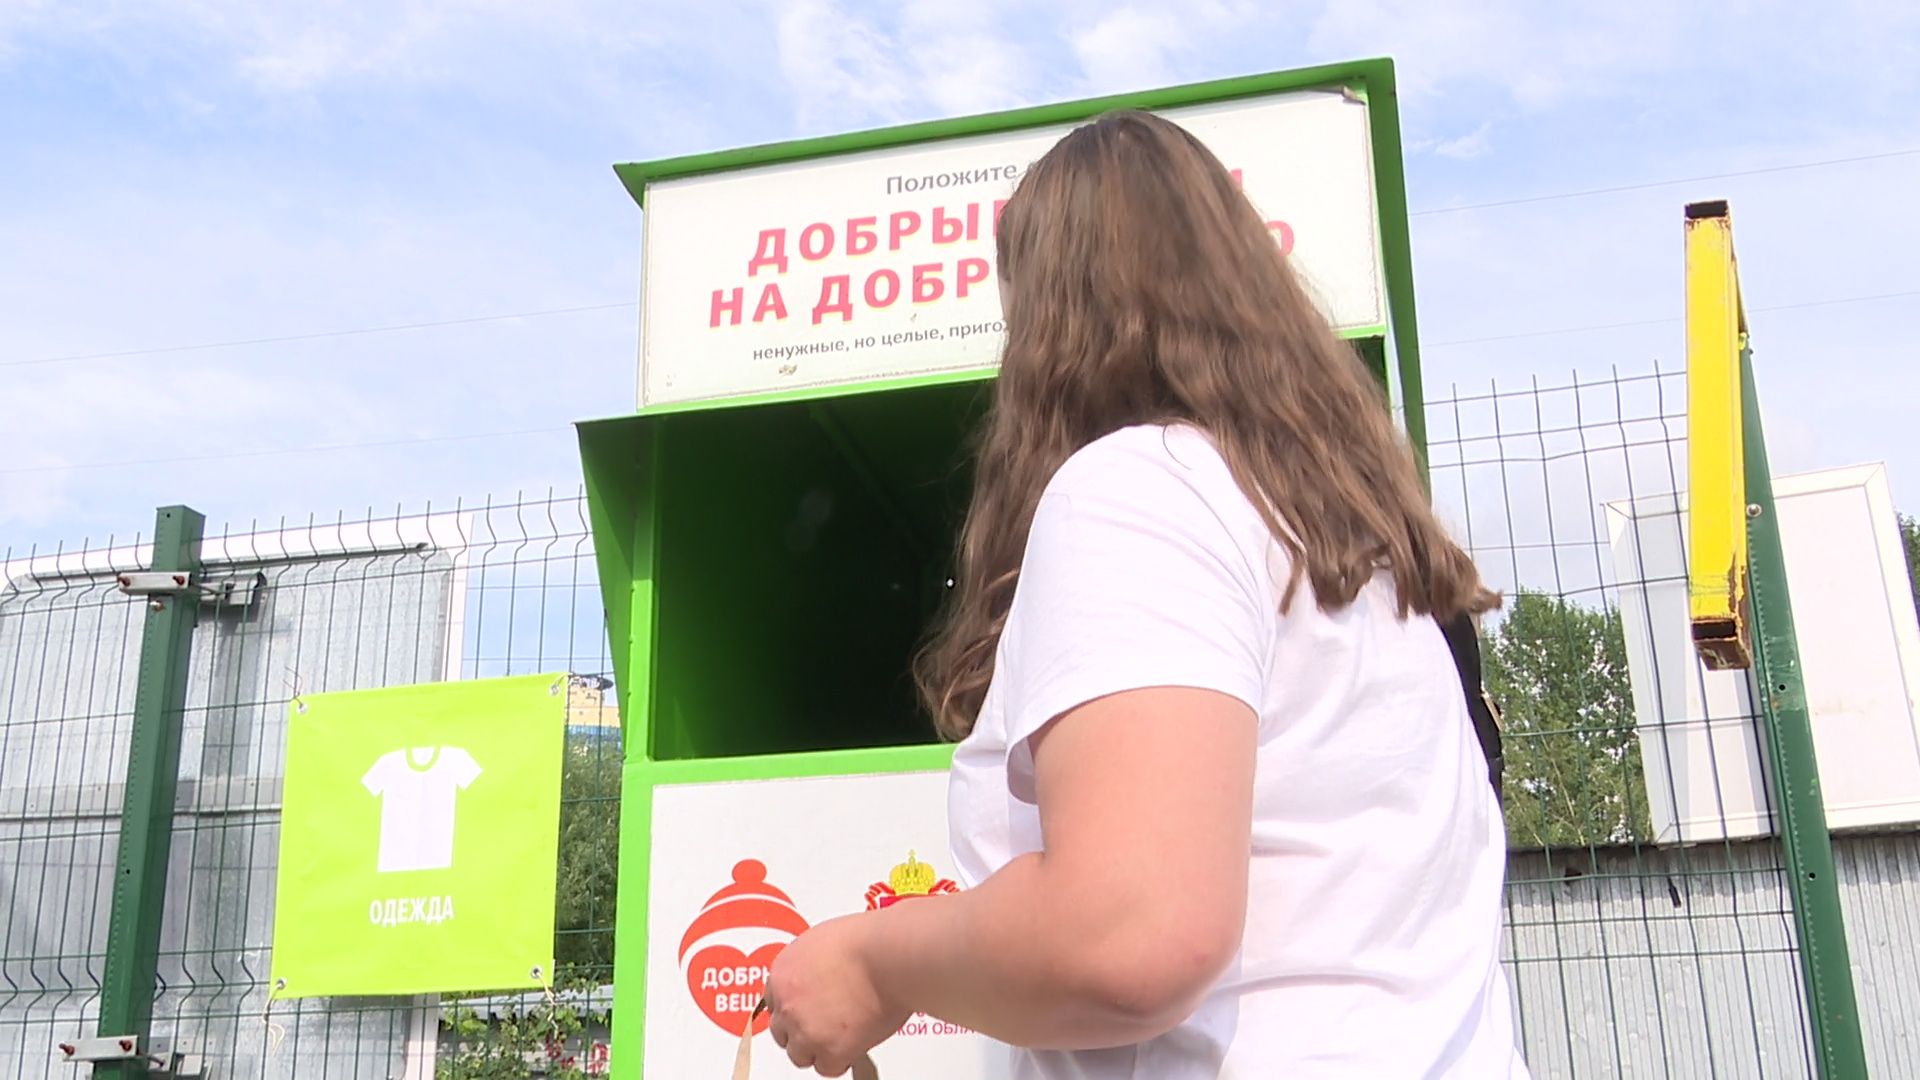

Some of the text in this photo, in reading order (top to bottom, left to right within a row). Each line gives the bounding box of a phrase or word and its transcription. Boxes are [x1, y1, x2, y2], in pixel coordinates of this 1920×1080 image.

[887, 163, 1018, 195] Положите
[747, 199, 1010, 278] ДОБРЫ
[709, 282, 789, 328] НА
[752, 339, 850, 361] ненужные,
[854, 336, 876, 350] но
[881, 328, 945, 348] целые,
[369, 895, 454, 928] ОДЕЖДА
